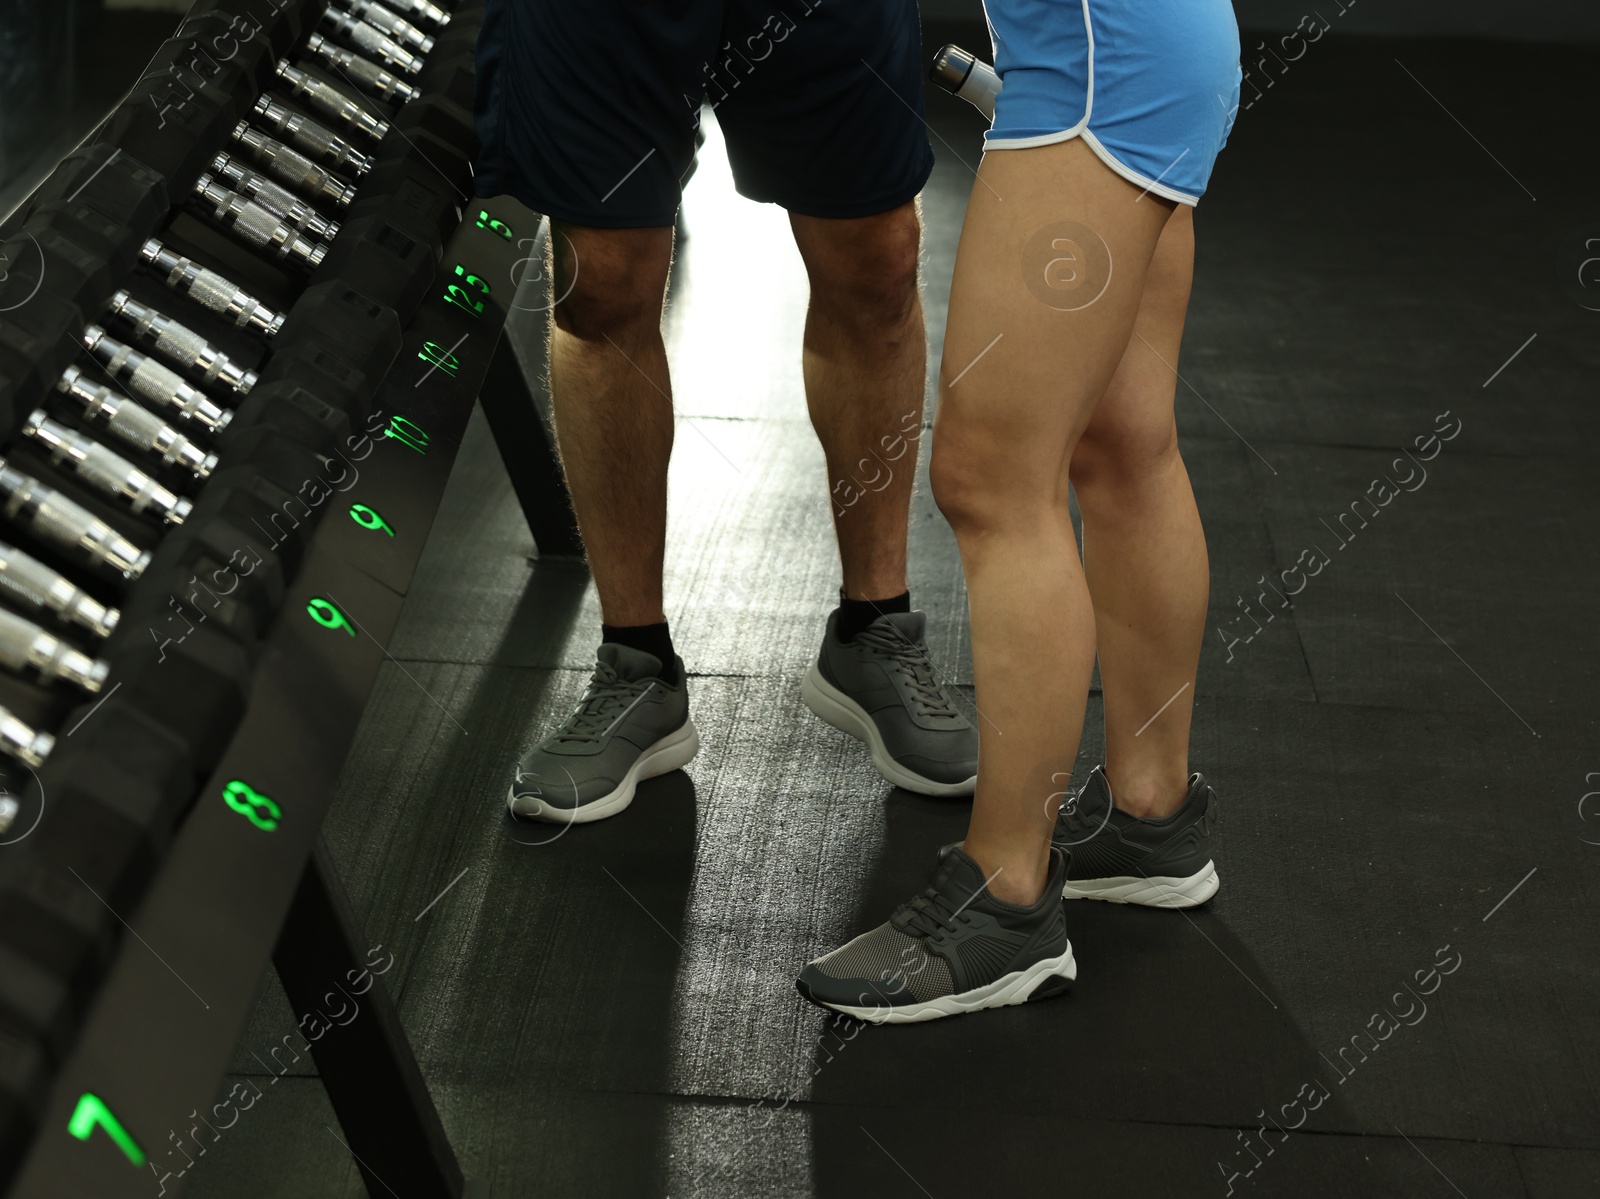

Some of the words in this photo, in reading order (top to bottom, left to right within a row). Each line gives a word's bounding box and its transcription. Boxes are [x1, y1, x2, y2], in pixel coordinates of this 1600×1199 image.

[475, 210, 513, 242] 15
[417, 341, 460, 378] 10
[383, 415, 430, 455] 10
[348, 503, 396, 538] 9
[306, 597, 357, 638] 9
[221, 779, 283, 832] 8
[66, 1091, 146, 1167] 7
